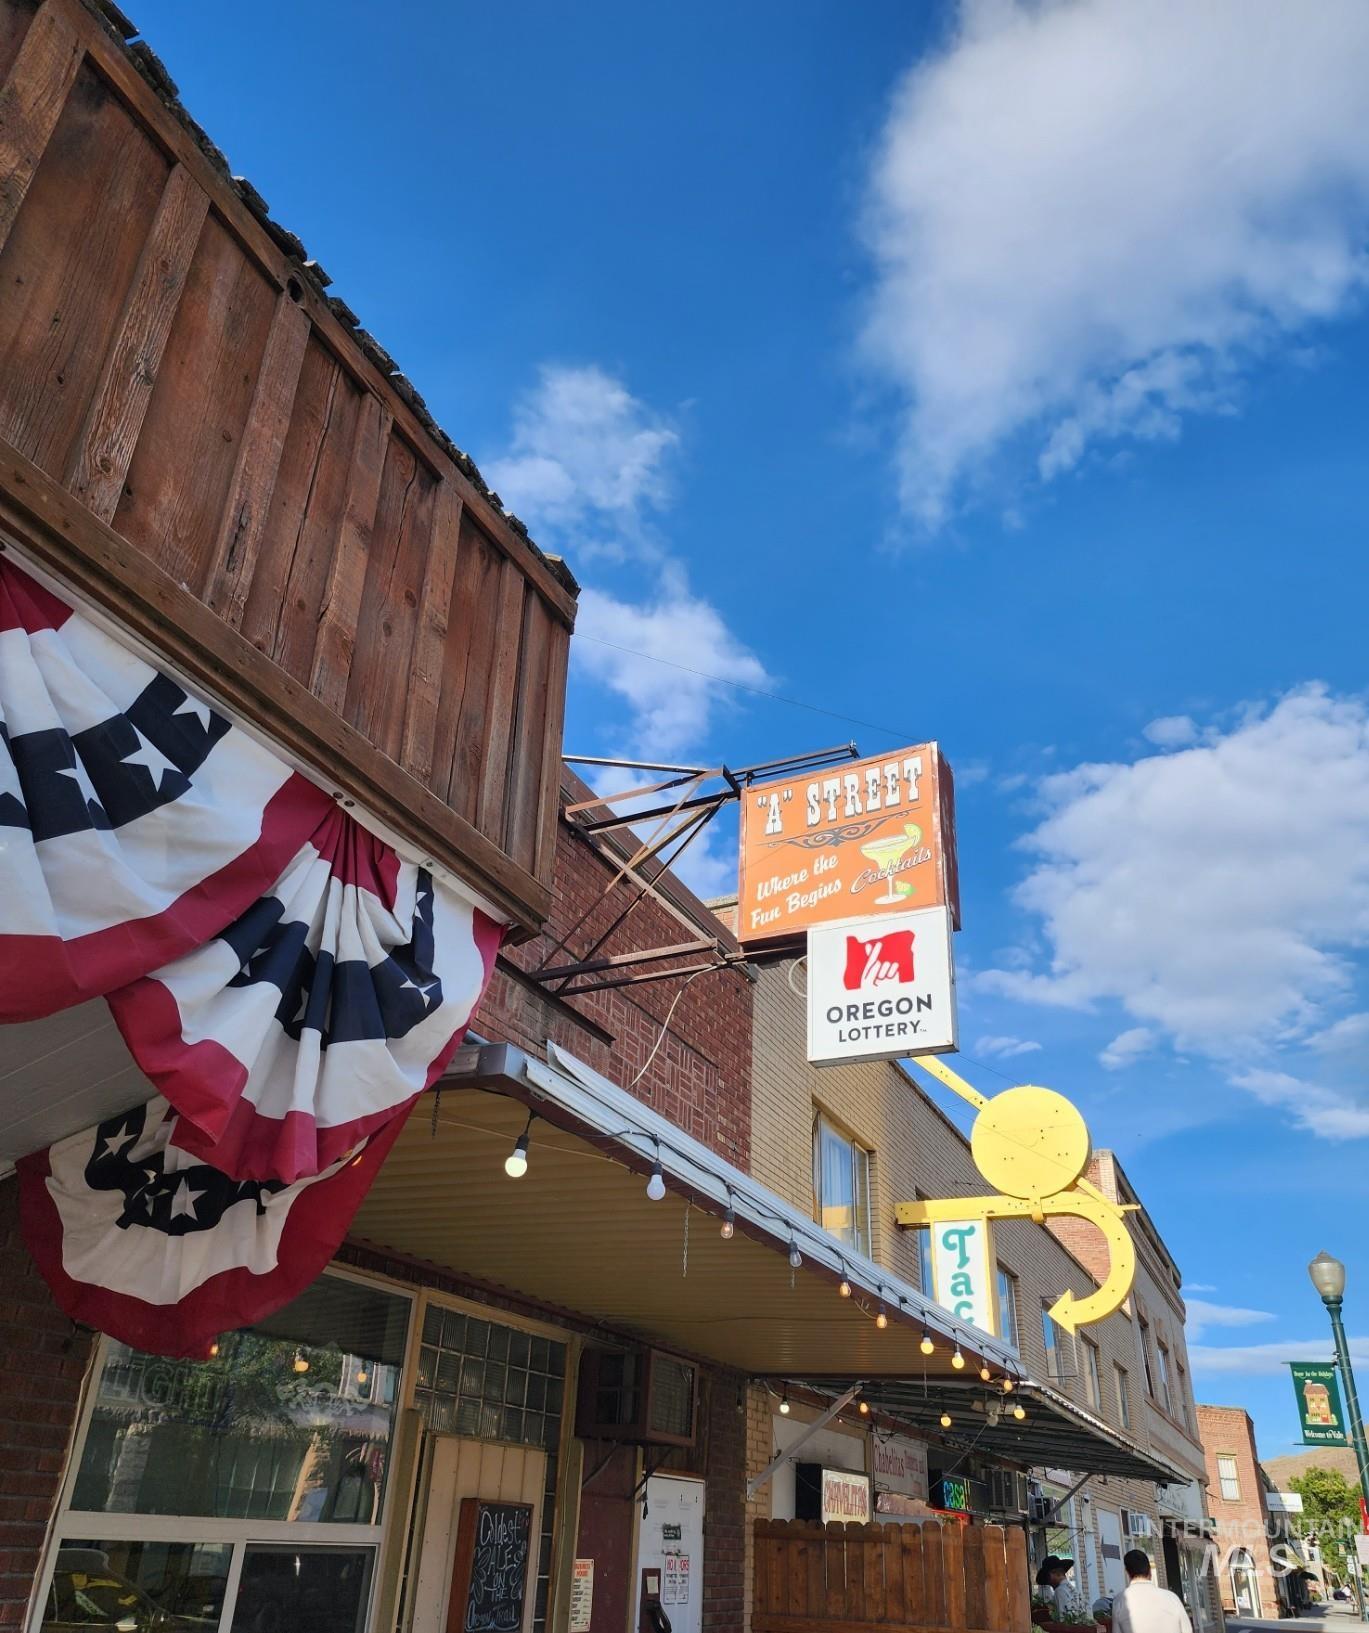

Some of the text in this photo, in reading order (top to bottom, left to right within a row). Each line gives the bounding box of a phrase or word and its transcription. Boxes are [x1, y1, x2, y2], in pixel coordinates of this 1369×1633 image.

[807, 756, 922, 828] STREET
[756, 854, 838, 900] Where the
[850, 847, 932, 895] Cocktails
[750, 879, 842, 929] Fun Begins
[826, 993, 932, 1024] OREGON
[839, 1020, 920, 1042] LOTTERY
[480, 1510, 521, 1546] Coldest
[484, 1583, 508, 1601] THE
